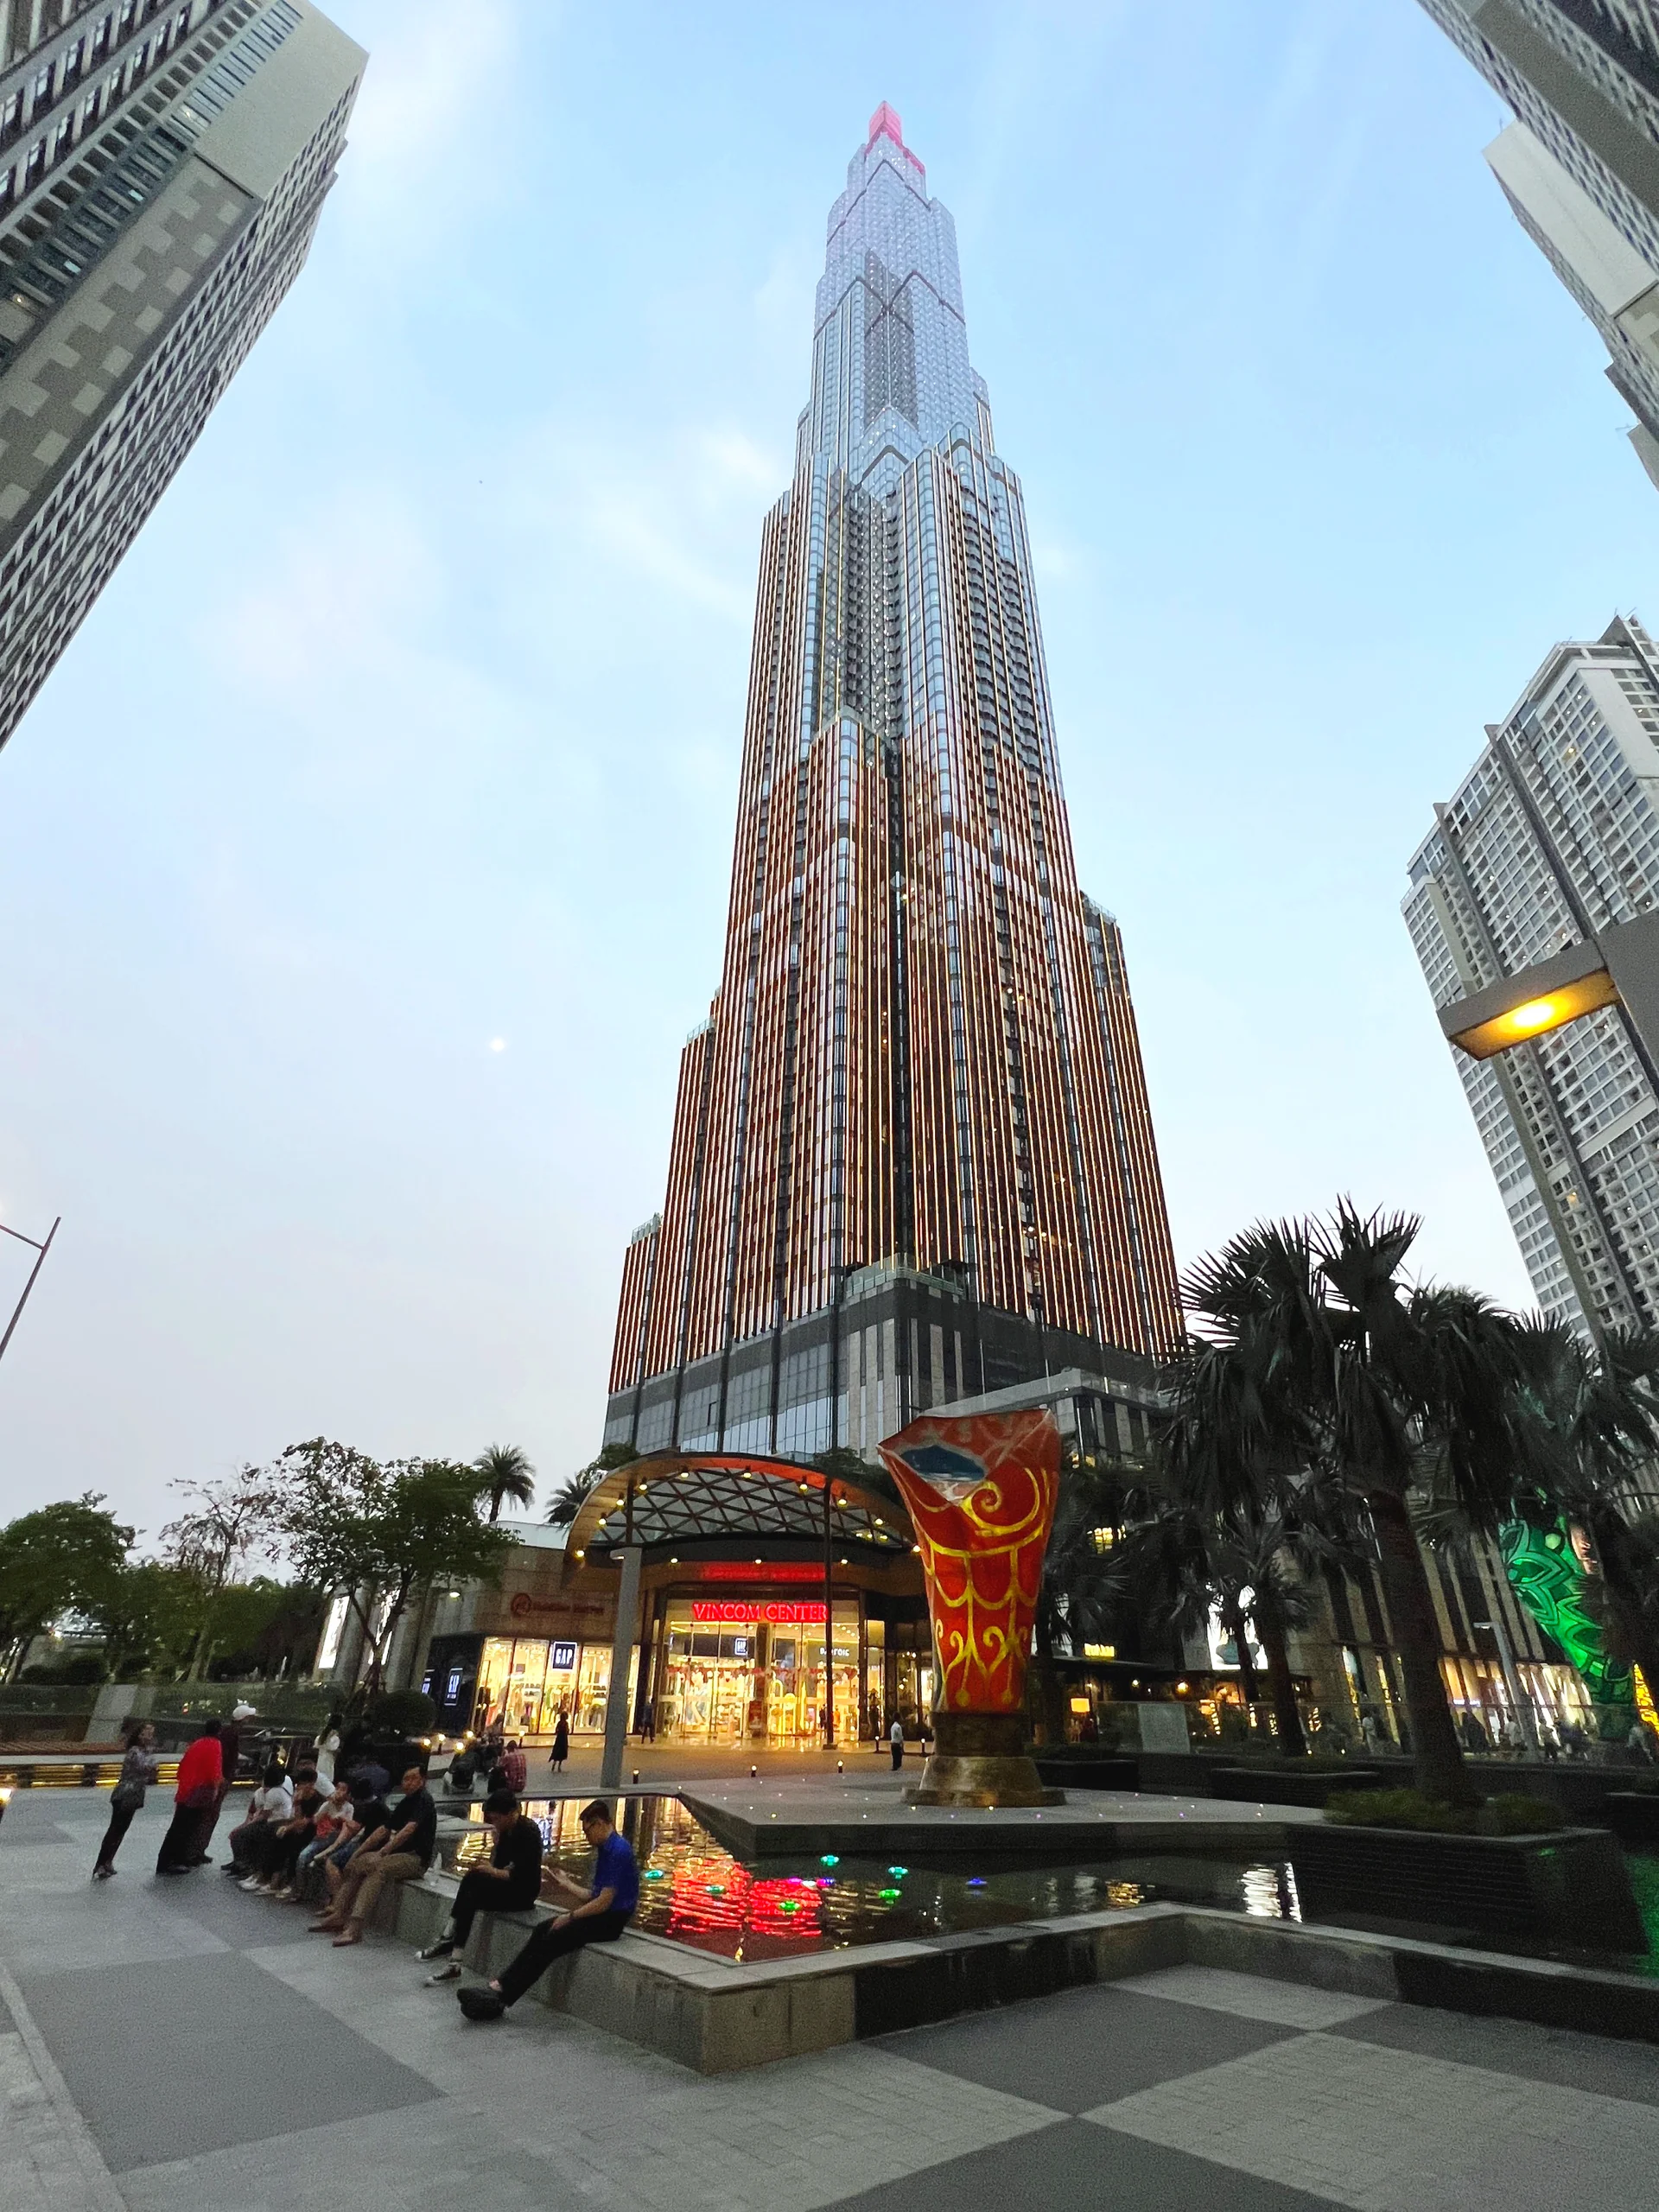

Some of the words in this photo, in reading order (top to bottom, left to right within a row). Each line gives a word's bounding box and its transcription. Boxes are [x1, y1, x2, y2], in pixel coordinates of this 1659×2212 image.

[693, 1603, 760, 1620] VINCOM
[765, 1603, 828, 1621] CENTER
[556, 1648, 573, 1665] GAP
